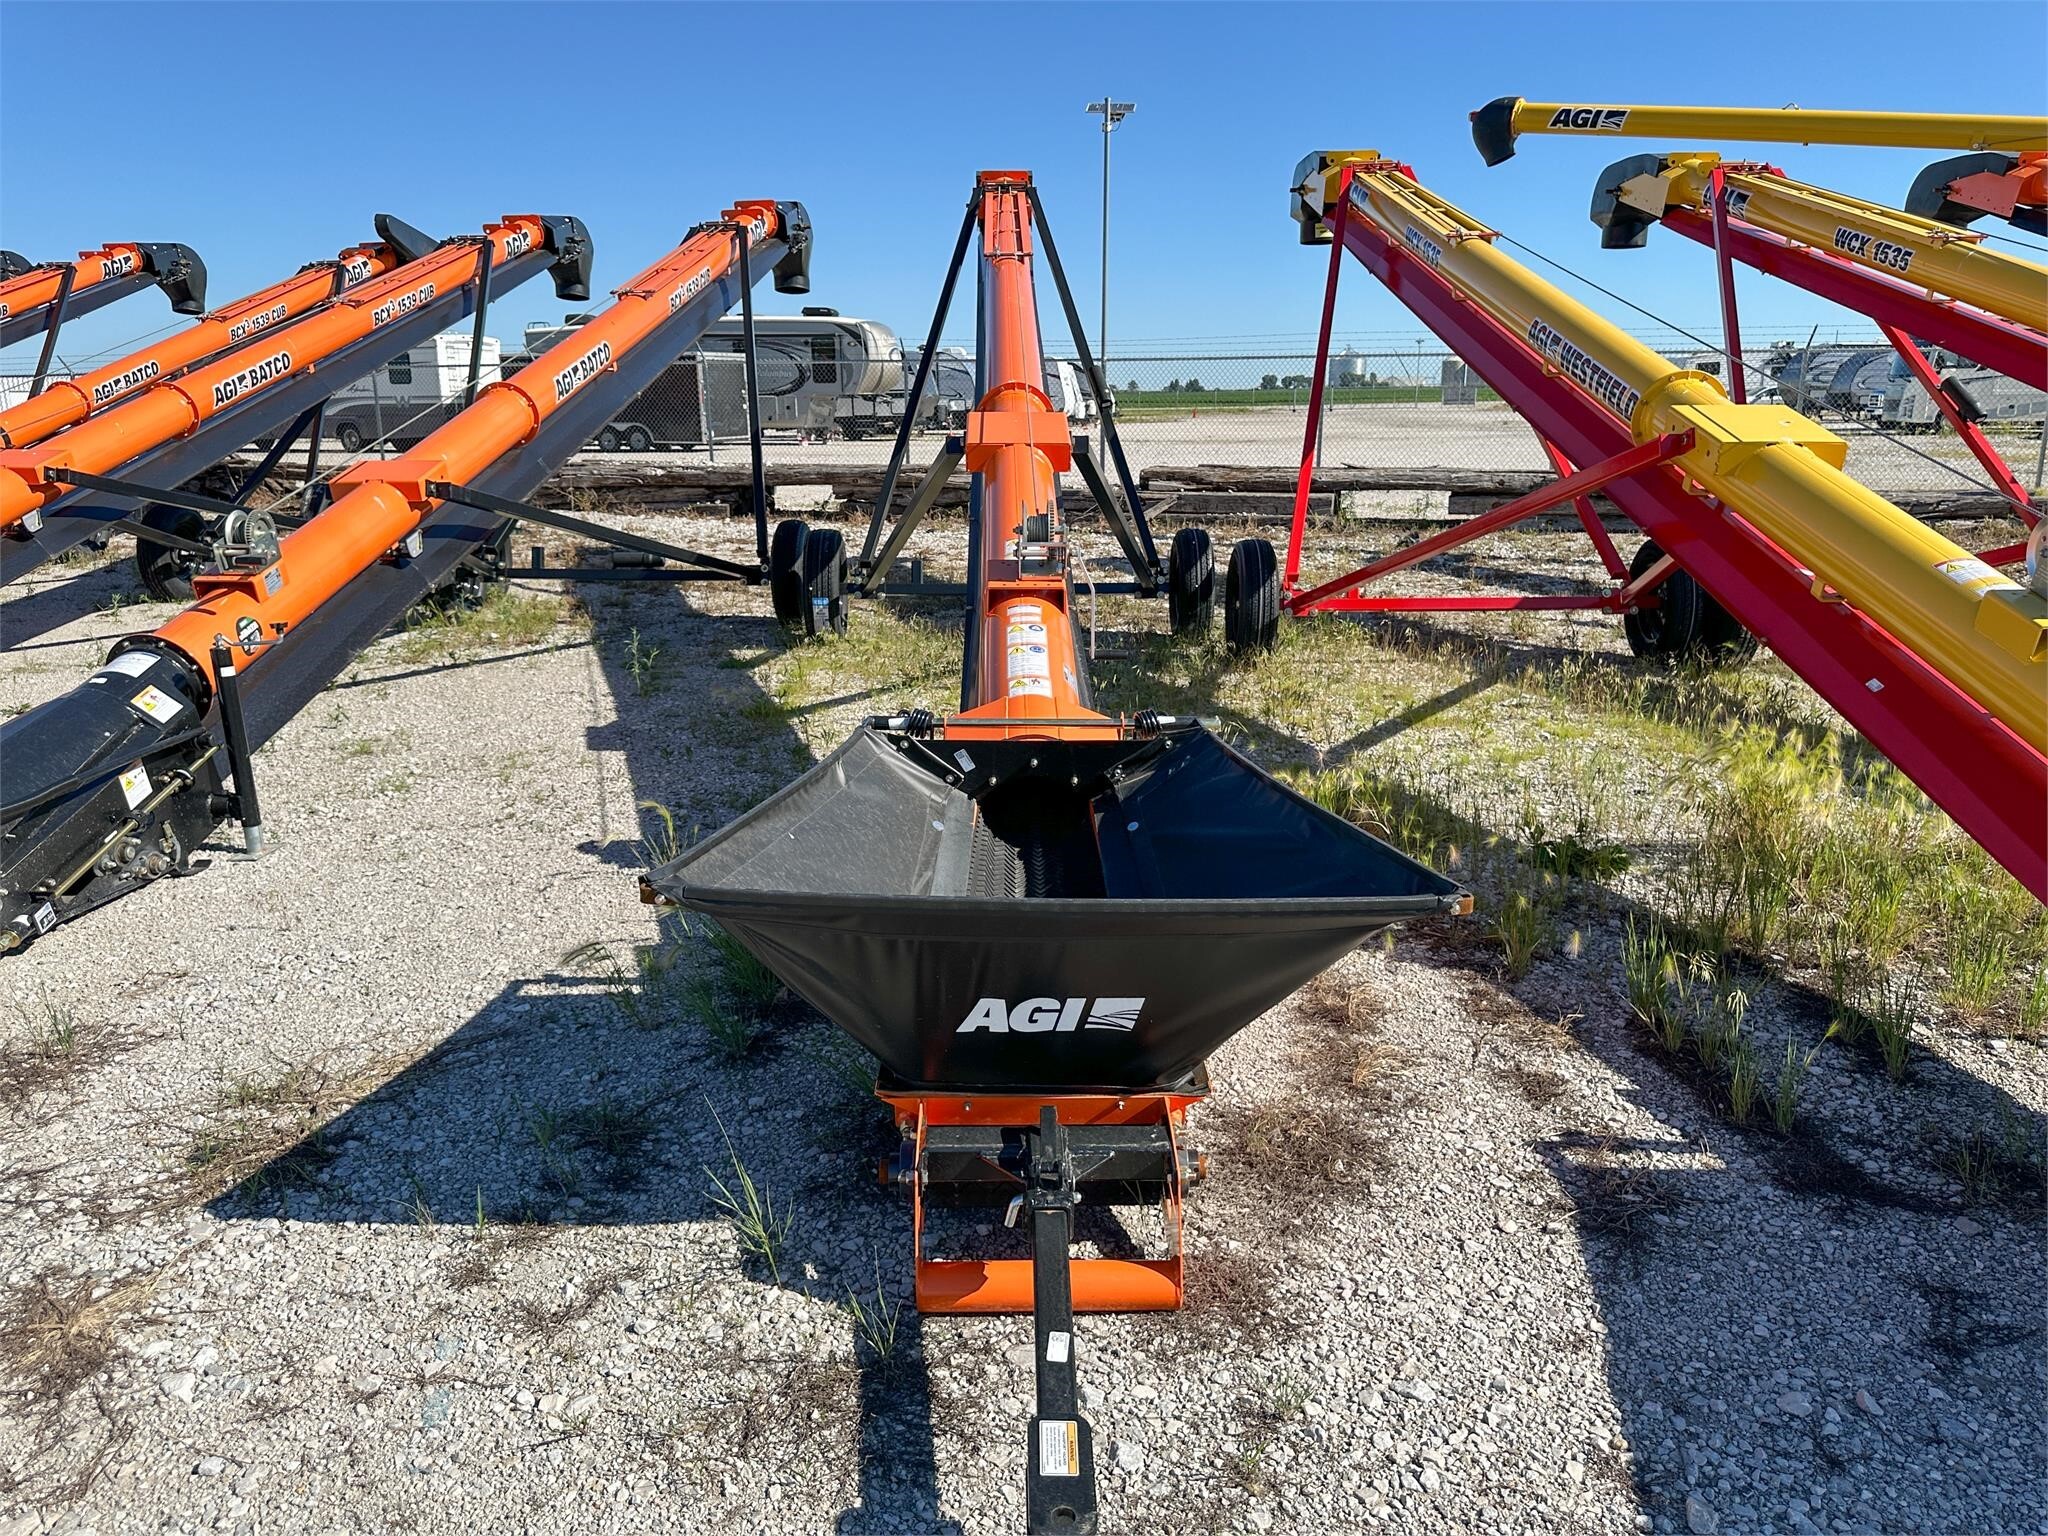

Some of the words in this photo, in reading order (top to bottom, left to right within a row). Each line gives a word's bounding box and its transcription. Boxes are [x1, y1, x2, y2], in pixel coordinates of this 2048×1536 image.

[1549, 108, 1604, 129] AGI
[505, 232, 523, 260] AGI
[1834, 227, 1873, 258] WCX
[1873, 241, 1914, 272] 1535
[102, 258, 123, 280] AGI
[346, 261, 364, 286] AGI
[397, 292, 418, 315] 1539
[418, 284, 436, 304] CUB
[251, 312, 270, 331] 1539
[271, 304, 287, 321] CUB
[94, 382, 115, 404] AGI
[122, 360, 160, 390] BATCO
[214, 379, 239, 408] AGI
[248, 352, 291, 388] BATCO
[555, 370, 574, 402] AGI
[579, 342, 611, 381] BATCO
[1527, 319, 1553, 357] AGI
[1560, 341, 1640, 423] WESTFIELD
[954, 997, 1088, 1033] AGI
